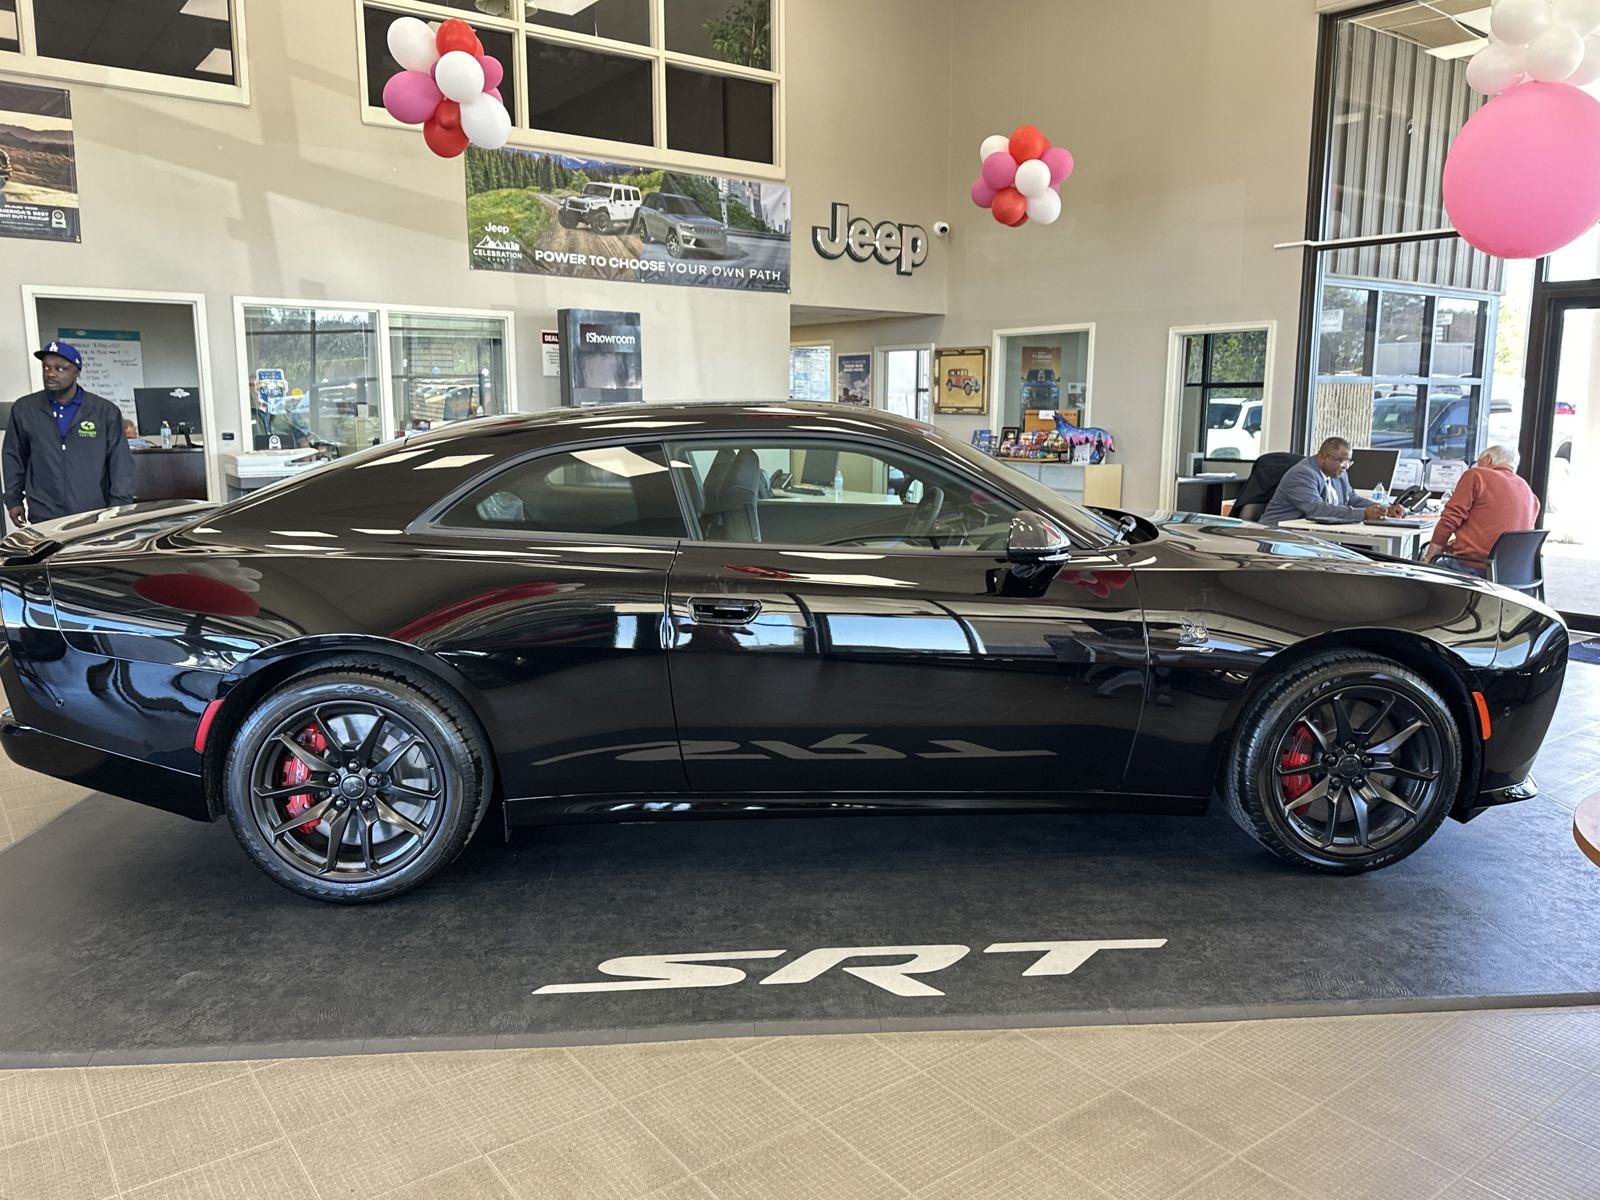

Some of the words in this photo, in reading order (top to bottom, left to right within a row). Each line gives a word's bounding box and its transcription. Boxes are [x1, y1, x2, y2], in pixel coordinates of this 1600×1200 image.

[0, 208, 31, 216] MERICA'S
[484, 222, 510, 235] Jeep
[811, 202, 929, 276] Jeep
[473, 248, 523, 259] CELEBRATION
[534, 249, 587, 266] POWER
[588, 255, 607, 267] TO
[608, 257, 666, 272] CHOOSE
[667, 262, 707, 275] YOUR
[712, 266, 746, 278] OWN
[749, 269, 781, 281] PATH
[585, 331, 636, 345] iShowroom
[531, 938, 1168, 996] SRT
